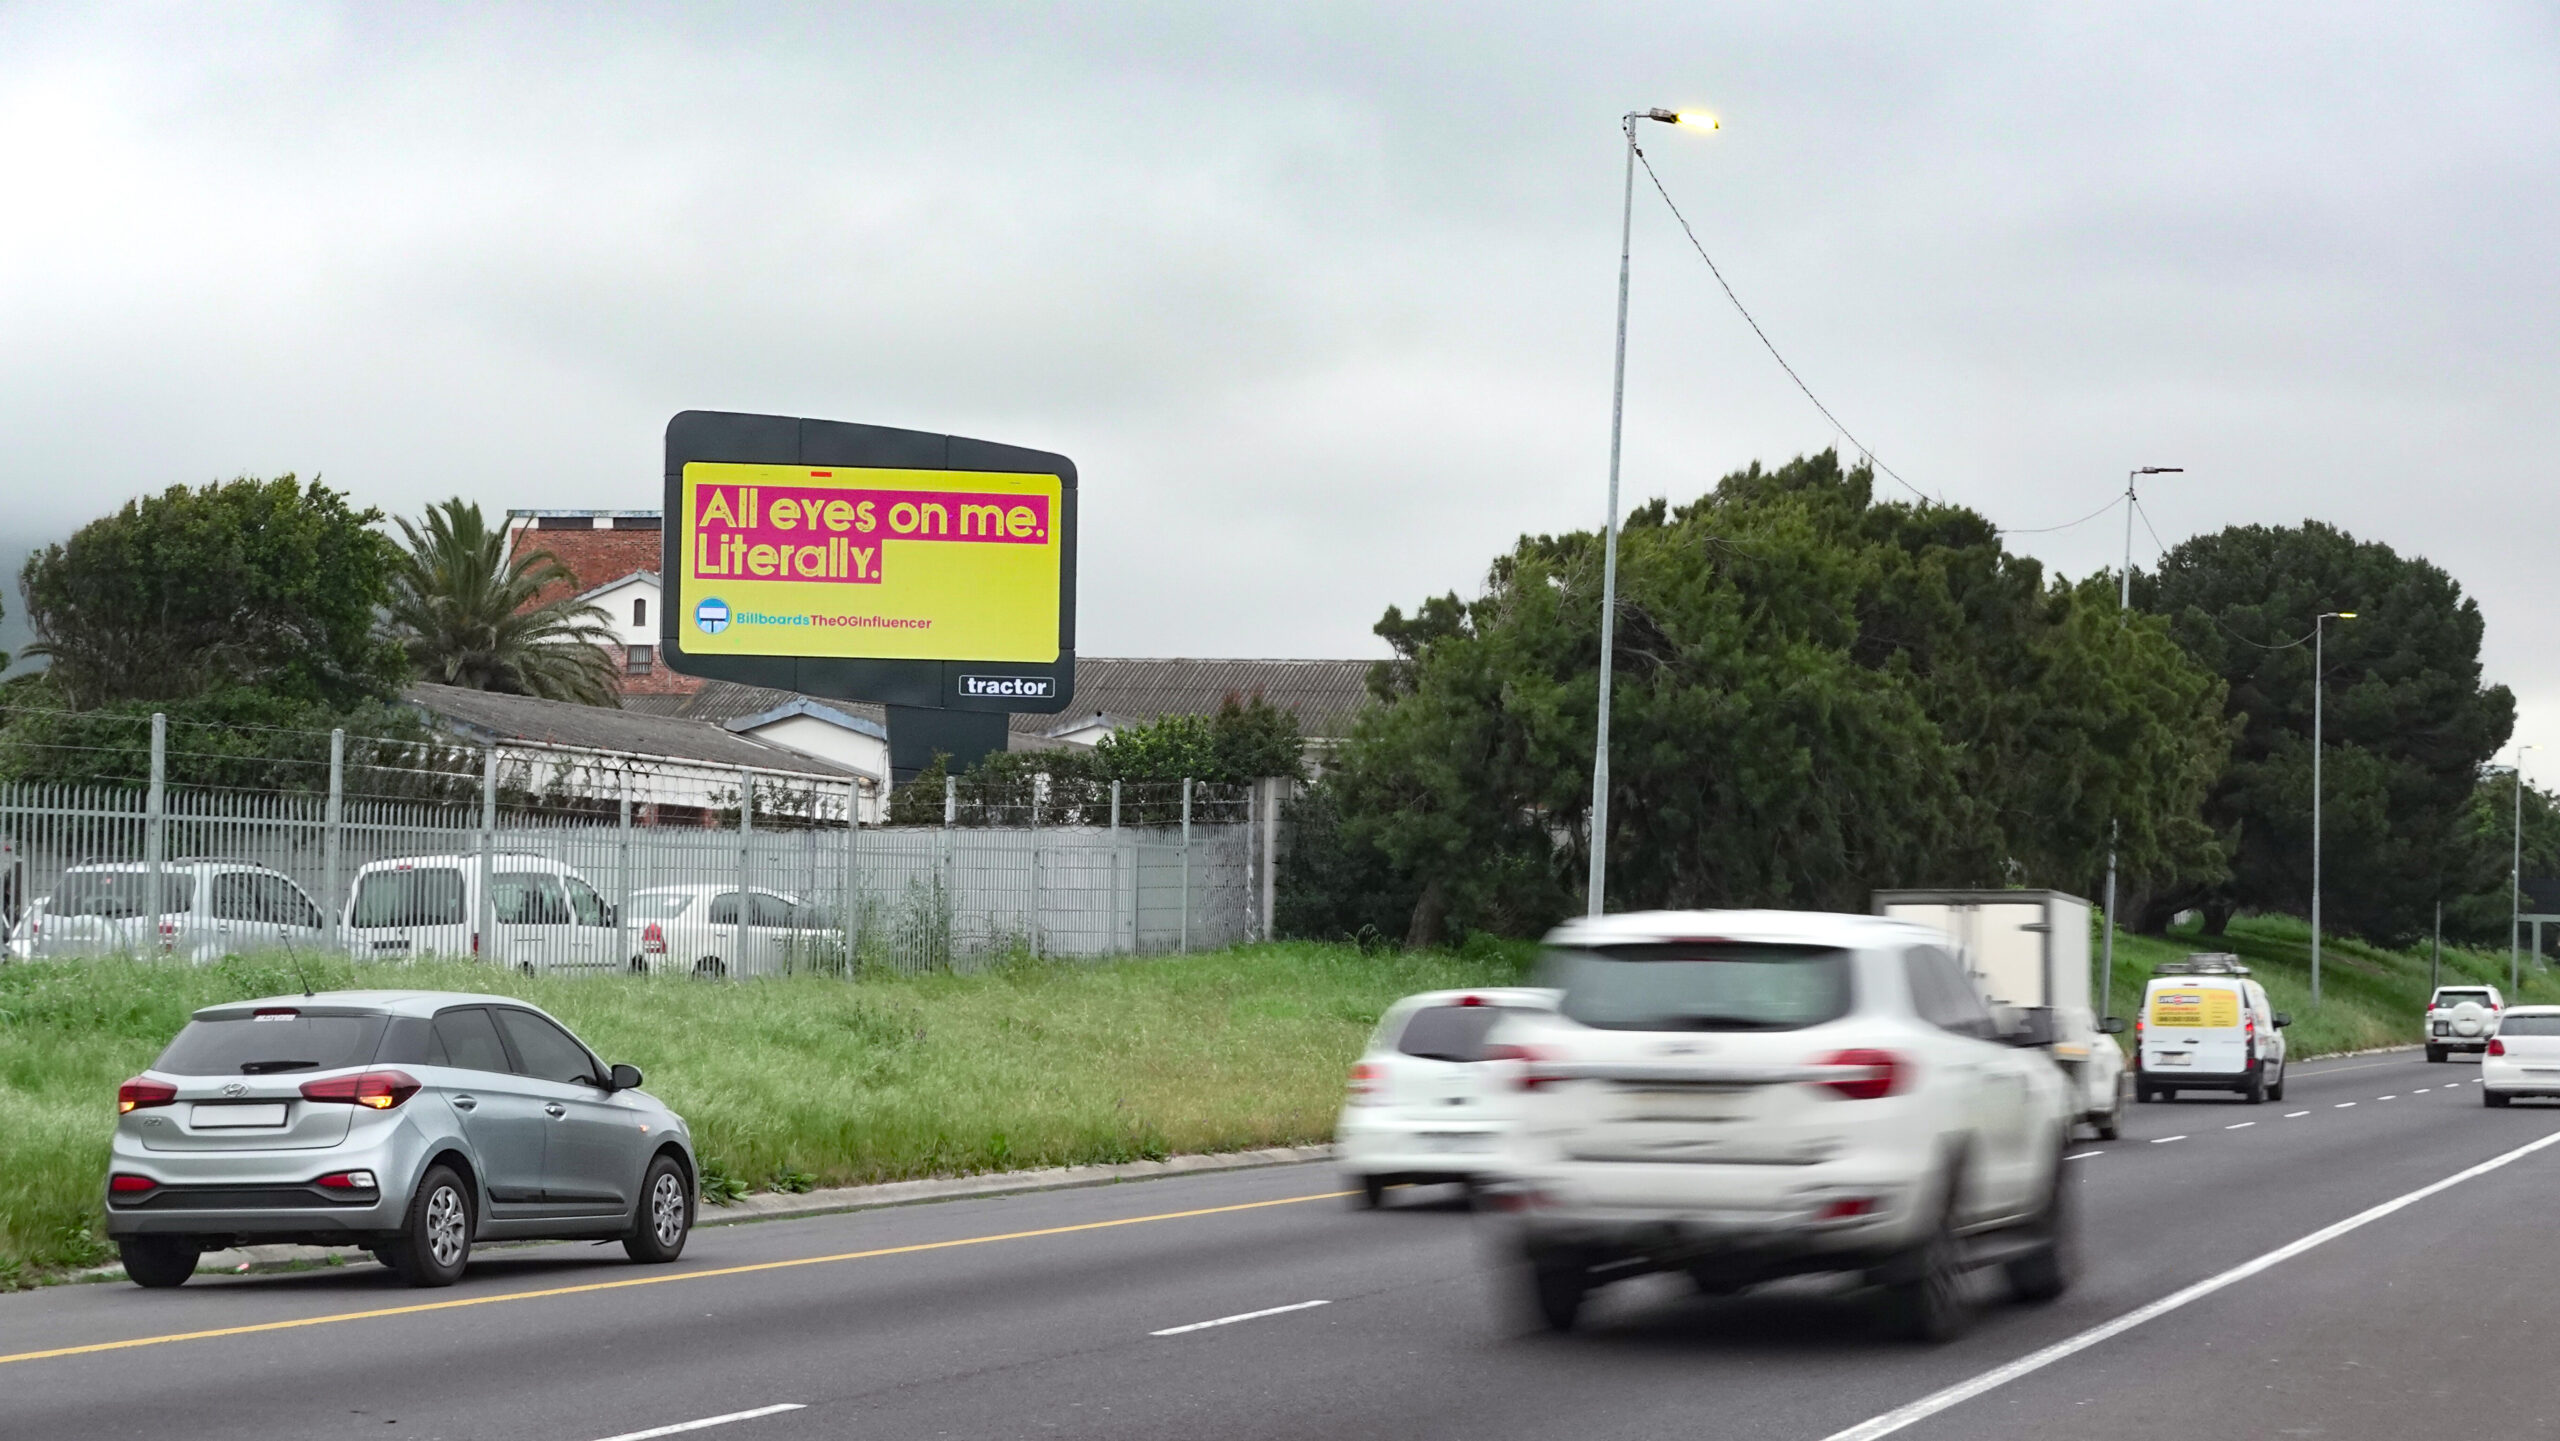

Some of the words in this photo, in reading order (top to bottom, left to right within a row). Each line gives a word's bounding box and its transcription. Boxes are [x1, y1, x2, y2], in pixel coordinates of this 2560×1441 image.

[698, 487, 758, 529] All
[769, 498, 877, 533] eyes
[888, 502, 948, 534] on
[959, 503, 1045, 538] me.
[698, 533, 880, 579] Literally.
[736, 612, 932, 629] BillboardsTheOGInfluencer
[967, 677, 1047, 695] tractor
